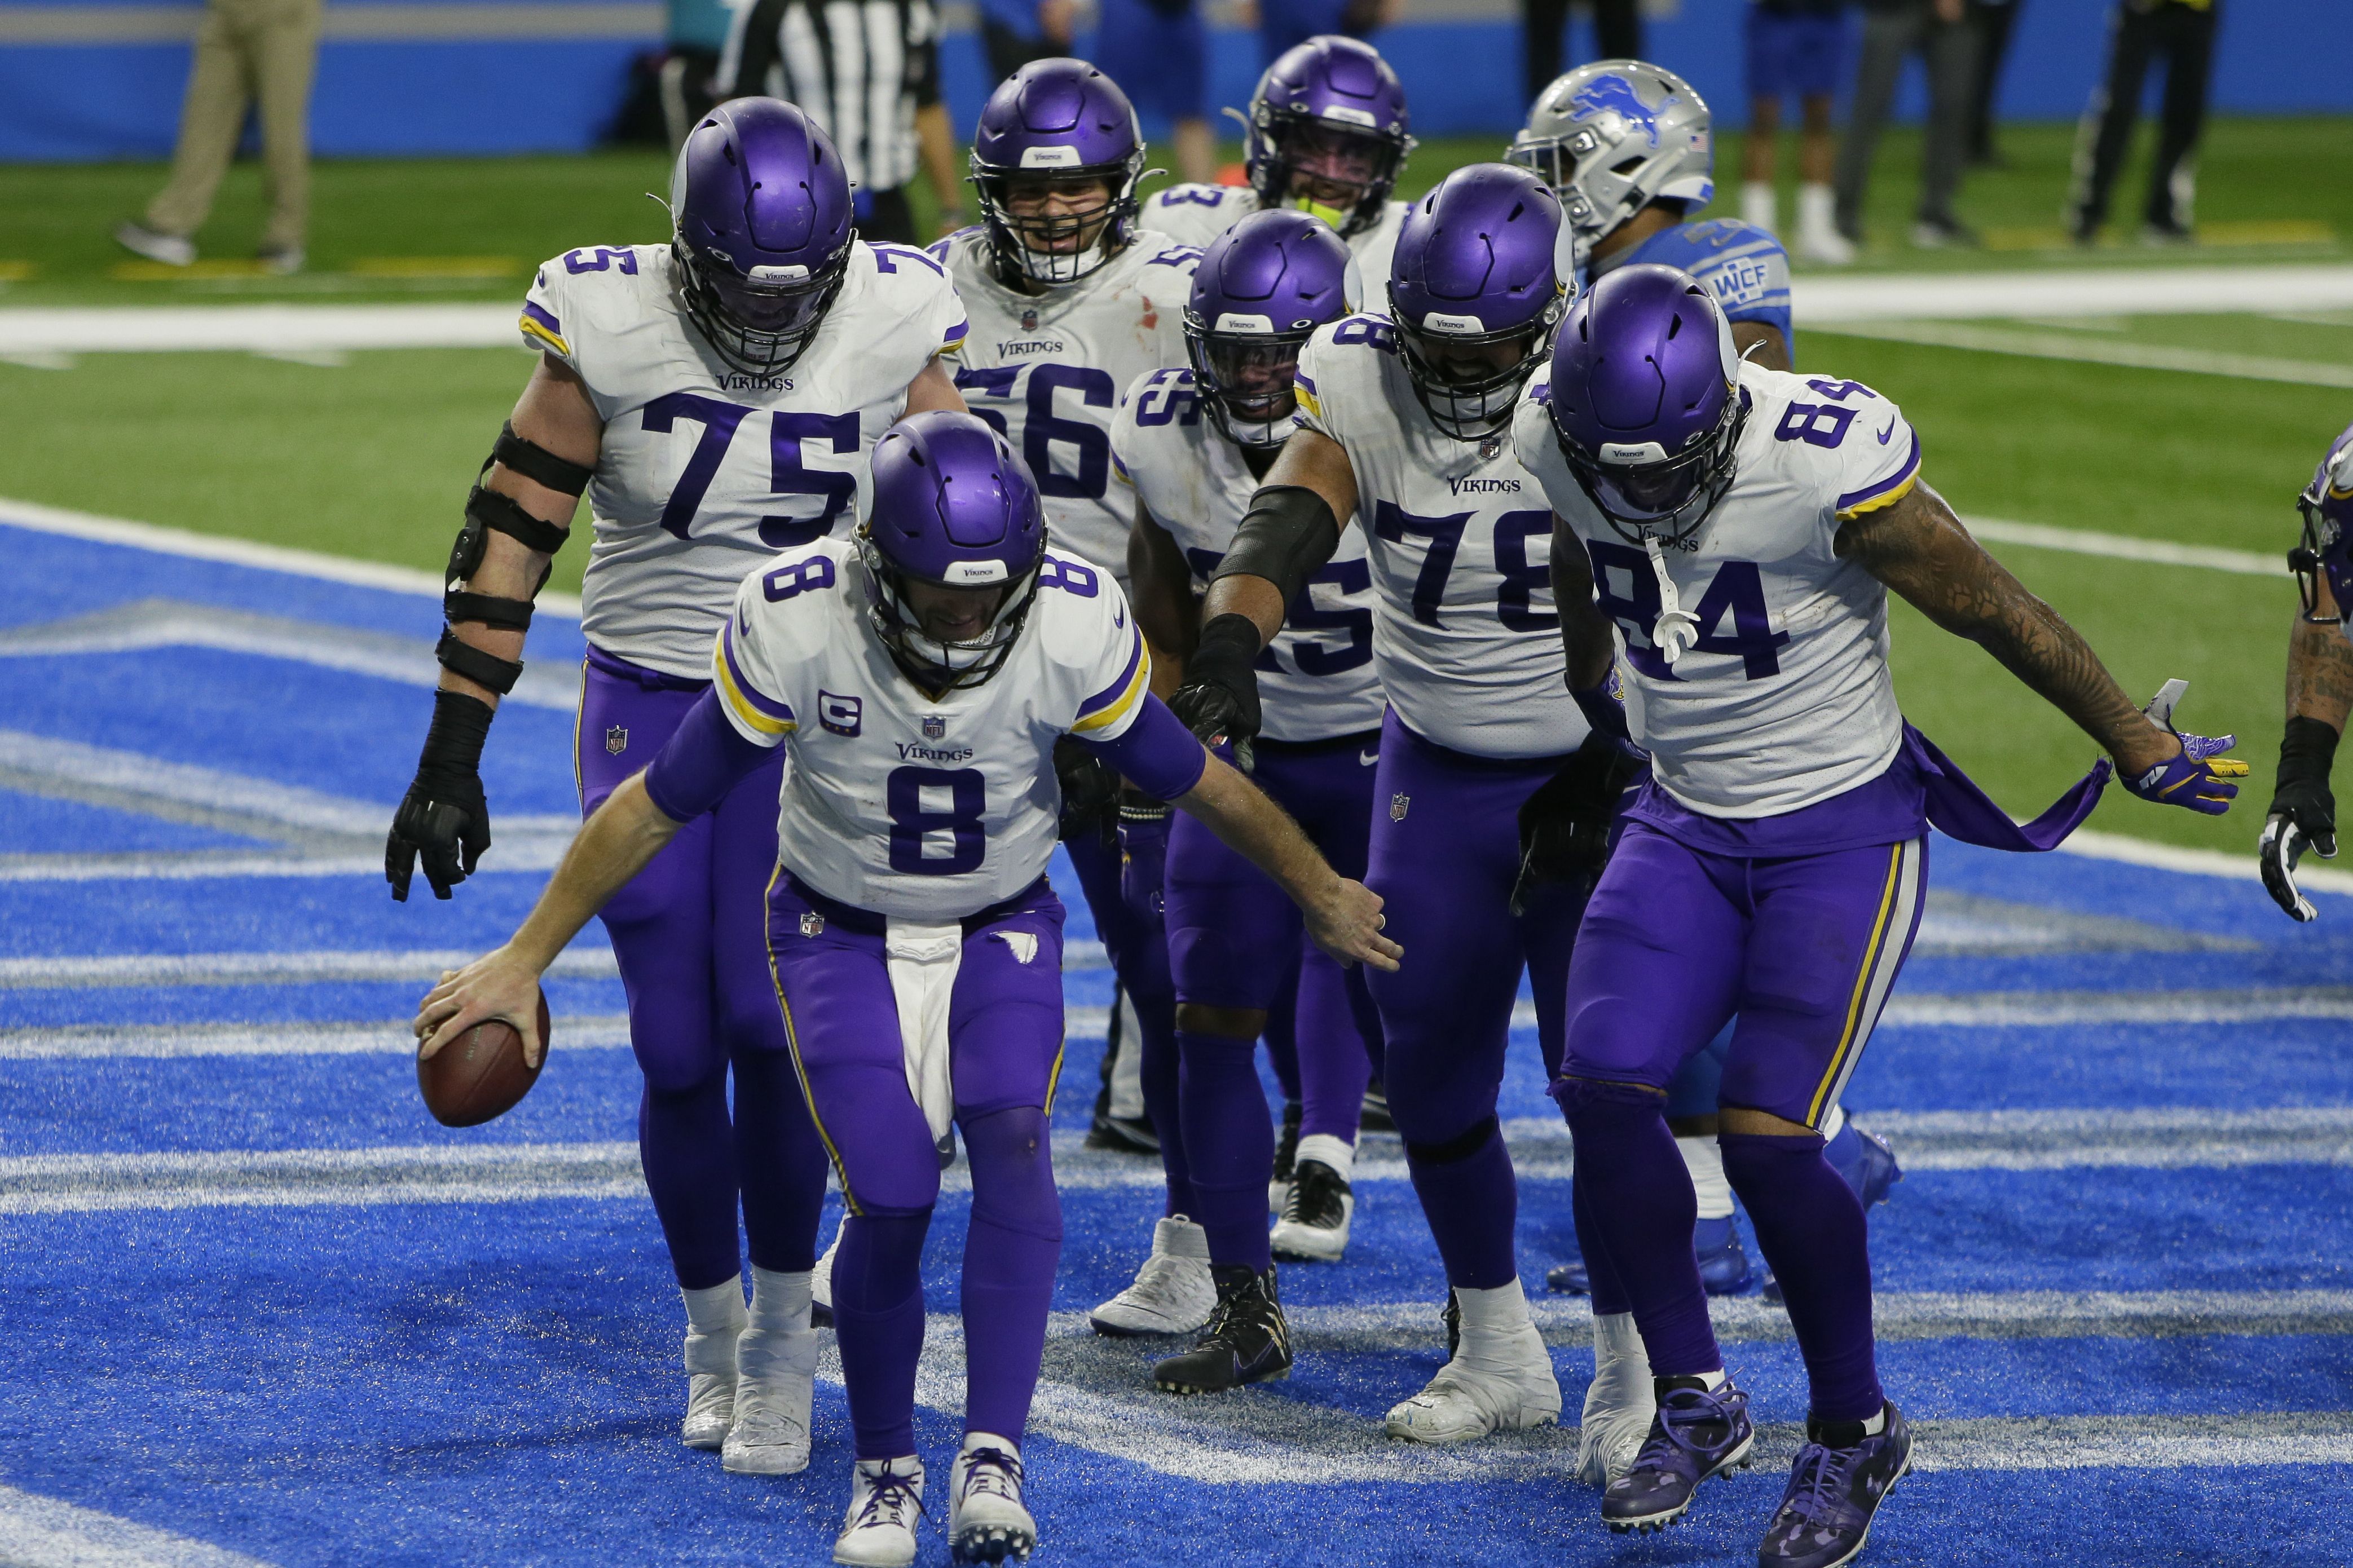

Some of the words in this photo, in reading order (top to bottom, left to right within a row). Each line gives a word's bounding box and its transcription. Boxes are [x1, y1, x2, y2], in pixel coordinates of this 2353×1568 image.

[1161, 187, 1225, 208] 3
[563, 245, 639, 276] 5
[865, 240, 945, 279] 7
[1714, 264, 1766, 297] WCF
[1332, 312, 1399, 356] 8
[1436, 319, 1465, 329] VIKINGS
[997, 339, 1063, 360] VIKINGS
[715, 372, 794, 392] VIKINGS
[1774, 379, 1877, 449] 84
[1613, 449, 1645, 458] VIKINGS
[641, 392, 861, 548] 75
[1447, 470, 1521, 496] VIKINGS
[1635, 523, 1710, 553] VIKIGS
[763, 555, 835, 603] 8
[964, 568, 993, 577] VIKINGS
[1036, 554, 1099, 598] 8
[1374, 499, 1560, 633] 78
[1585, 538, 1791, 682] 84
[821, 695, 858, 727] C
[926, 726, 942, 736] NFL
[895, 741, 973, 763] VIKINGS
[887, 766, 986, 876] 8
